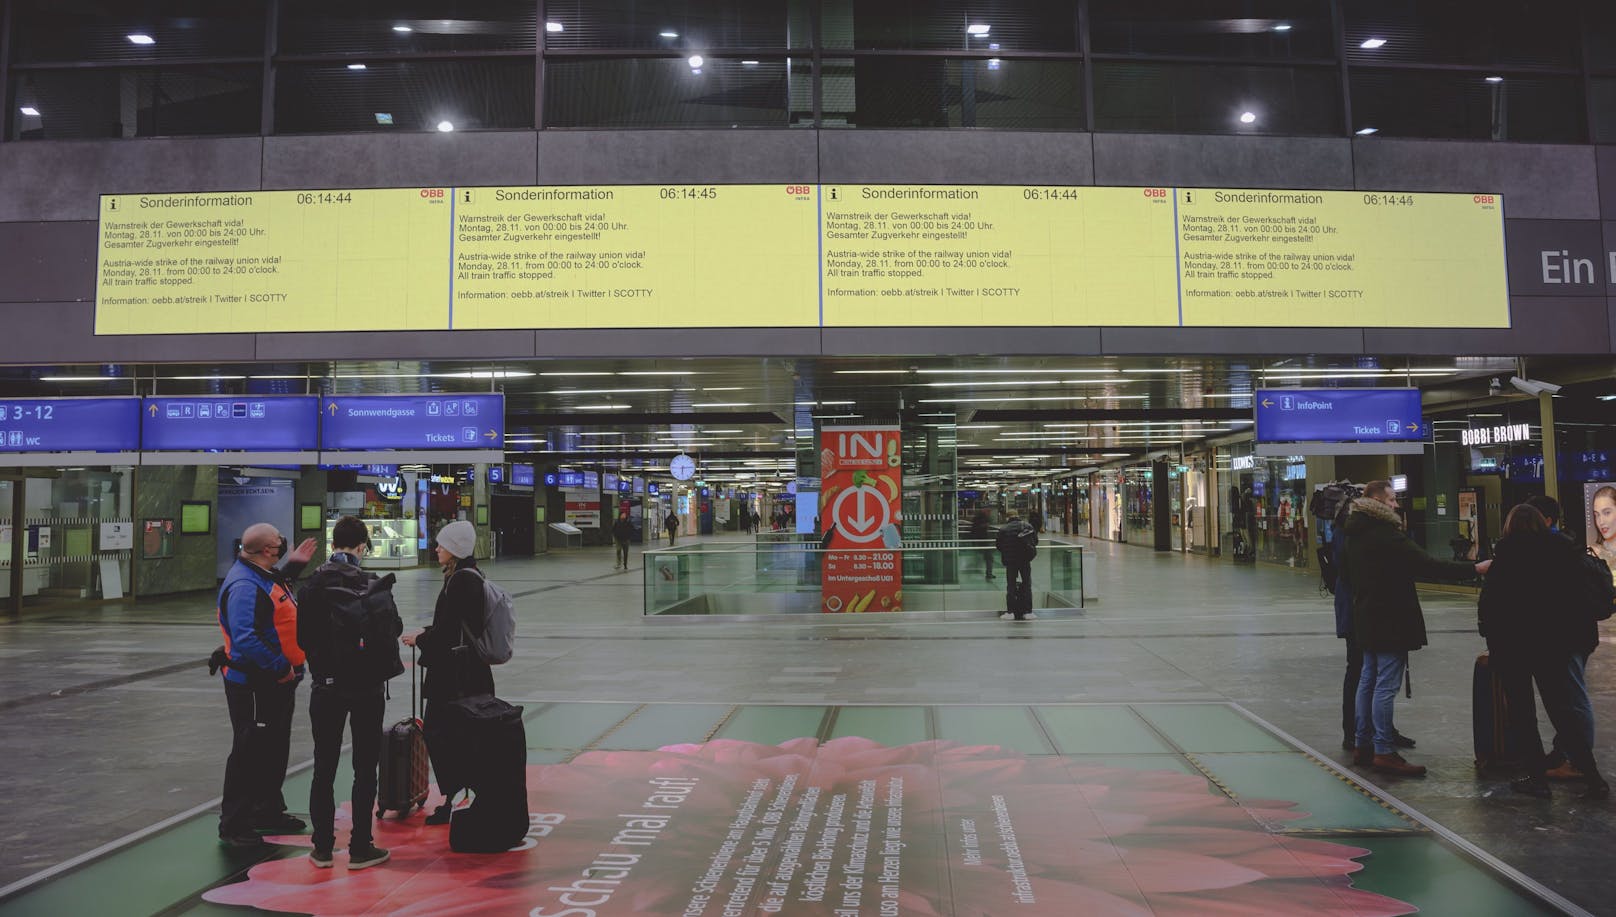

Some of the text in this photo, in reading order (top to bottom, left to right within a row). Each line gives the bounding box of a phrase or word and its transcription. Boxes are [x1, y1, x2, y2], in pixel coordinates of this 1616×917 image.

[297, 192, 352, 204] 06:14:44
[495, 188, 613, 200] Sonderinformation
[660, 188, 716, 199] 06:14:45
[862, 187, 978, 200] Sonderinformation
[1023, 188, 1078, 200] 06:14:44
[1214, 191, 1322, 204] Sonderinformation
[140, 195, 252, 208] Sonderinformation
[458, 214, 504, 222] Warnstreik
[523, 213, 582, 221] Gewerkschaft
[826, 211, 871, 219] Warnstreik
[890, 212, 948, 220] Gewerkschaft
[1182, 214, 1224, 222] Warnstreik
[1242, 215, 1295, 223] Gewerkschaft
[104, 221, 147, 229] Warnstreik
[166, 219, 221, 228] Gewerkschaft
[458, 232, 600, 242] Gesamter Zugverkehr eingestellt!
[826, 230, 967, 240] Gesamter Zugverkehr eingestellt!
[1224, 233, 1269, 243] Zugverkehr
[1271, 234, 1313, 243] eingestellt!
[104, 238, 238, 249] Gesamter Zugverkehr eingestellt!
[458, 252, 511, 260] Austria-wide
[566, 251, 596, 260] railway
[599, 251, 622, 259] union
[1542, 250, 1594, 284] Ein
[471, 271, 490, 279] train
[492, 271, 515, 279] traffic
[457, 290, 507, 299] Information:
[510, 289, 569, 298] oebb.at/streik
[613, 288, 652, 297] SCOTTY
[1298, 401, 1333, 410] InfoPoint
[348, 408, 415, 418] Sonnwendgasse
[1354, 426, 1380, 434] Tickets
[1461, 424, 1530, 446] BOBBI BROWN
[426, 433, 455, 442] Tickets
[838, 432, 882, 458] IN
[492, 470, 498, 479] 5
[547, 475, 554, 484] 6
[854, 810, 872, 818] die
[887, 808, 902, 826] unsere
[852, 820, 871, 831] und
[727, 828, 743, 840] am
[756, 825, 778, 839] Mio.
[881, 827, 901, 838] wie
[530, 777, 700, 917] Schau mal rauf!
[812, 827, 844, 859] Bio-Honig
[880, 840, 905, 854] liegt
[746, 847, 769, 862] über
[776, 832, 806, 880] ausgewählten
[843, 833, 869, 873] Klimaschutz
[692, 840, 739, 893] Schienenbiene
[736, 864, 760, 875] für
[878, 856, 900, 882] Herzen
[799, 861, 831, 901] köstlichen
[839, 876, 862, 889] der
[770, 881, 789, 896] auf
[880, 885, 898, 898] am
[723, 877, 756, 917] ertretend
[842, 891, 860, 906] uns
[683, 894, 710, 917] nsere
[758, 897, 783, 911] die
[880, 900, 898, 916] uso
